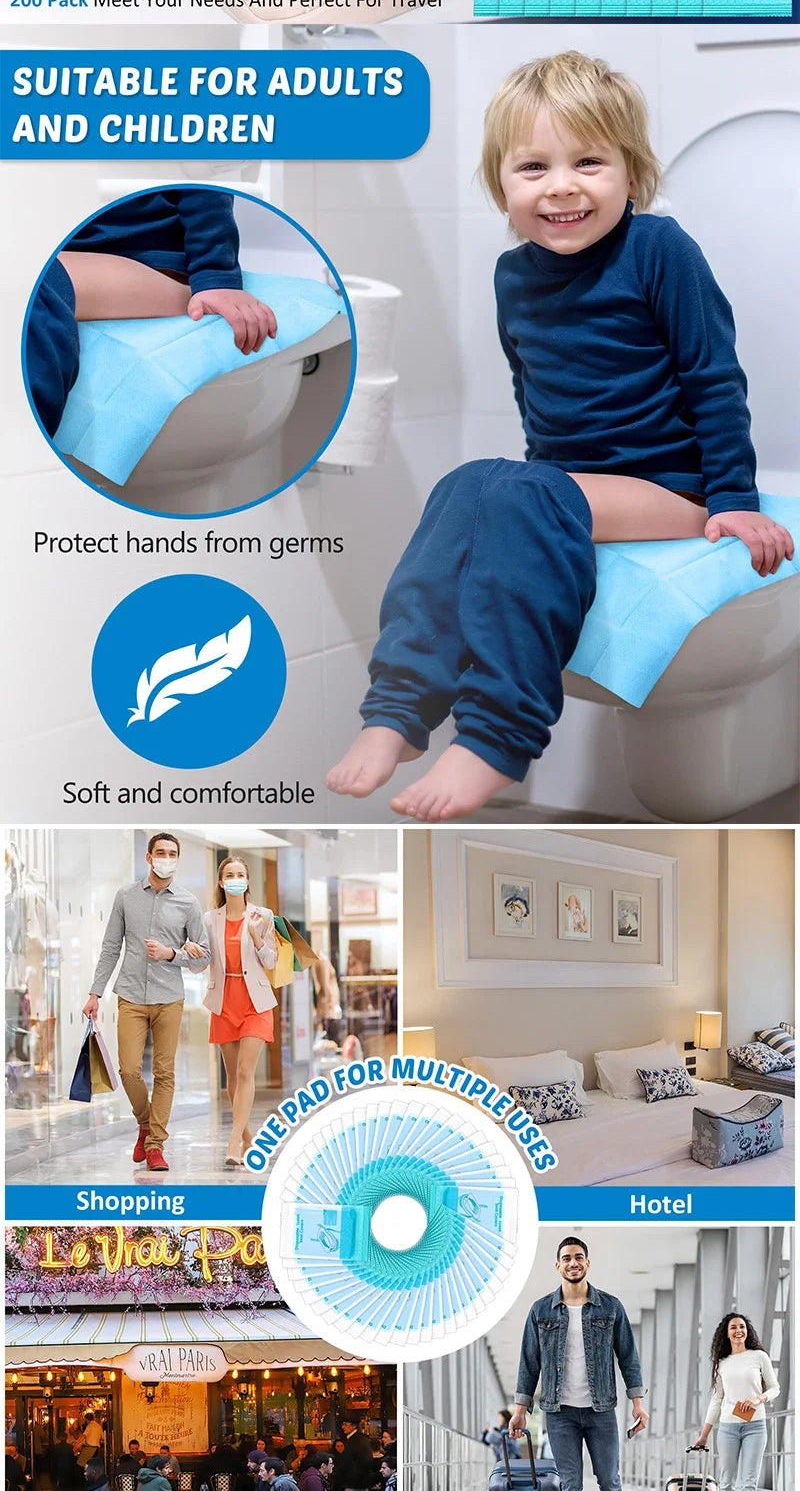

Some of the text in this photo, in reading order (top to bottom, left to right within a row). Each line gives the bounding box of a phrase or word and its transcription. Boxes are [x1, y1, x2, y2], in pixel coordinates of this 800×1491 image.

[39, 1232, 91, 1268] Le
[95, 1226, 181, 1274] Vrai
[139, 1347, 217, 1372] VRAI PARIS
